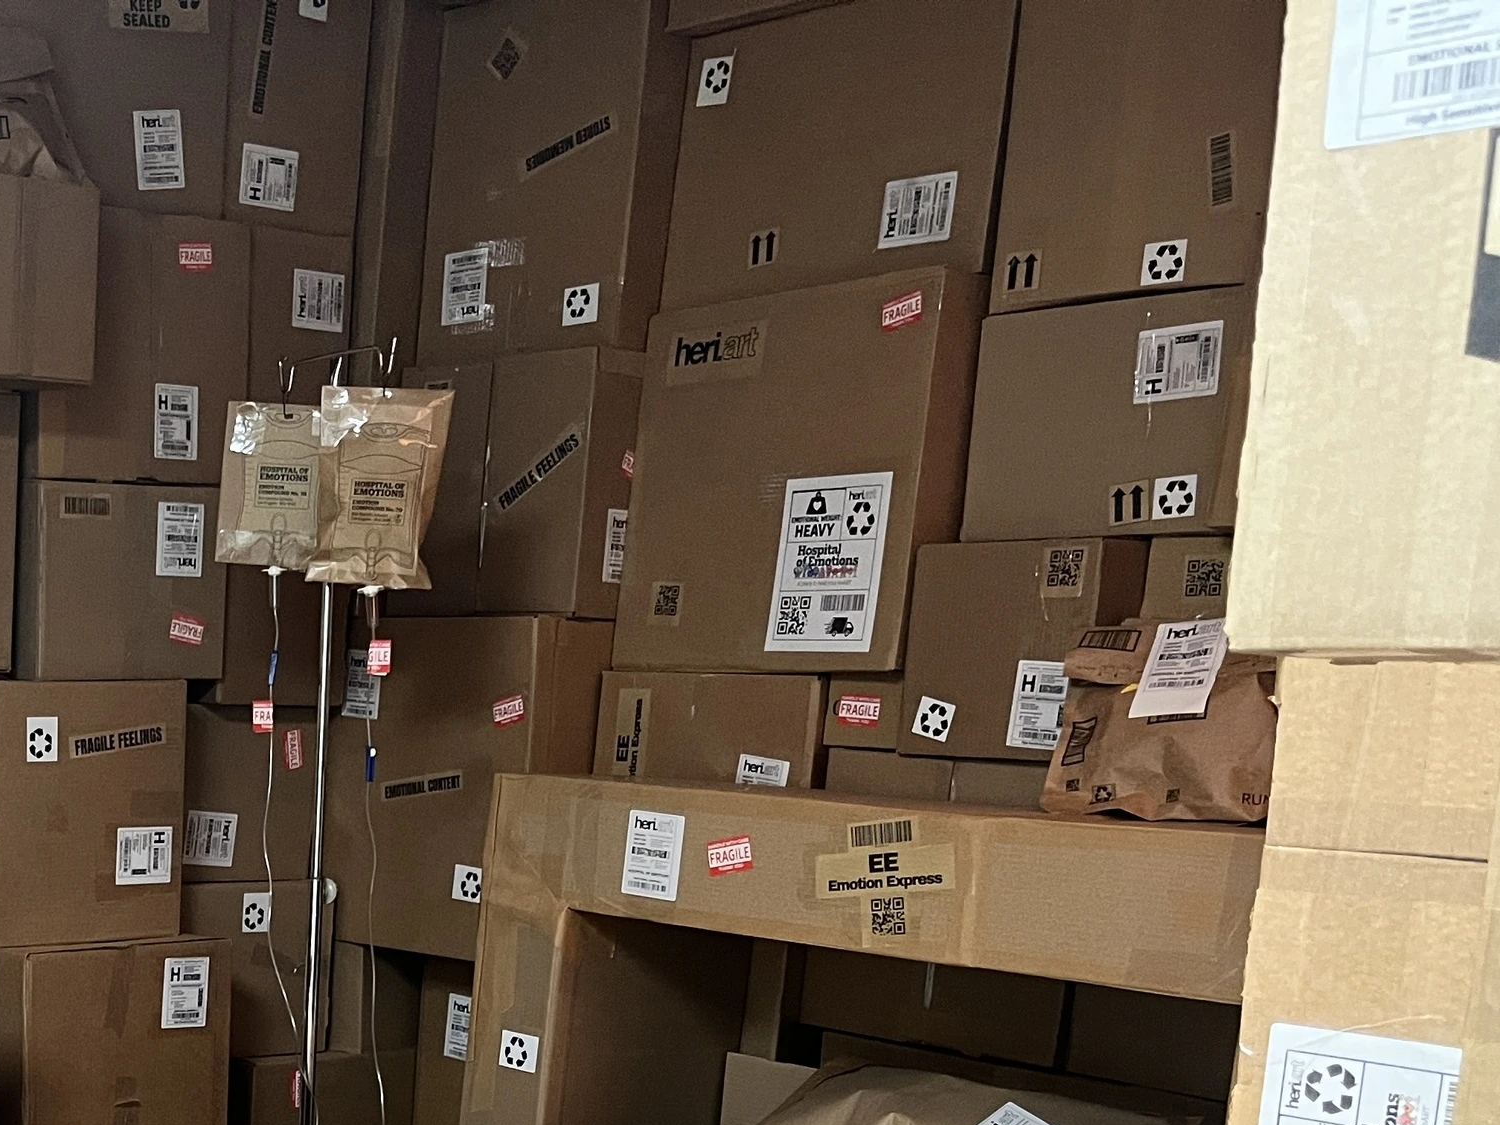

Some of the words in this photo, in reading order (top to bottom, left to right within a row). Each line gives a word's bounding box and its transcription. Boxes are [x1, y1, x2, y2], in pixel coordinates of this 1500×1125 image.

[129, 0, 161, 12] KEEP
[123, 13, 171, 27] SEALED
[249, 187, 262, 201] H
[181, 250, 211, 263] FRAGILE
[882, 299, 920, 326] FRAGILE
[673, 326, 759, 367] heri.art
[1145, 378, 1162, 395] H
[159, 394, 169, 410] H
[259, 466, 295, 475] HOSPITAL
[298, 467, 309, 475] OF
[259, 473, 309, 483] EMOTIONS
[499, 469, 538, 510] FRAGILE
[534, 433, 581, 480] FEELINGS
[353, 489, 405, 499] EMOTIONS
[354, 481, 390, 490] HOSPITAL
[393, 482, 405, 491] OF
[794, 522, 835, 538] HEAVY
[797, 542, 842, 557] Hospital
[808, 552, 859, 569] Emotions
[171, 621, 204, 637] FRAGILE
[1021, 674, 1036, 692] H
[841, 702, 879, 718] FRAGILE
[74, 737, 115, 757] FRAGILE
[118, 727, 163, 749] FEELINGS
[289, 730, 299, 768] FRAGILE
[616, 734, 630, 762] EE
[384, 780, 426, 799] EMOTIONAL
[428, 774, 461, 793] CONTENT
[154, 831, 166, 844] H
[709, 845, 750, 863] FRAGILE
[868, 852, 899, 873] EE
[827, 877, 883, 893] Emotion
[886, 871, 944, 890] Express
[171, 966, 182, 982] H
